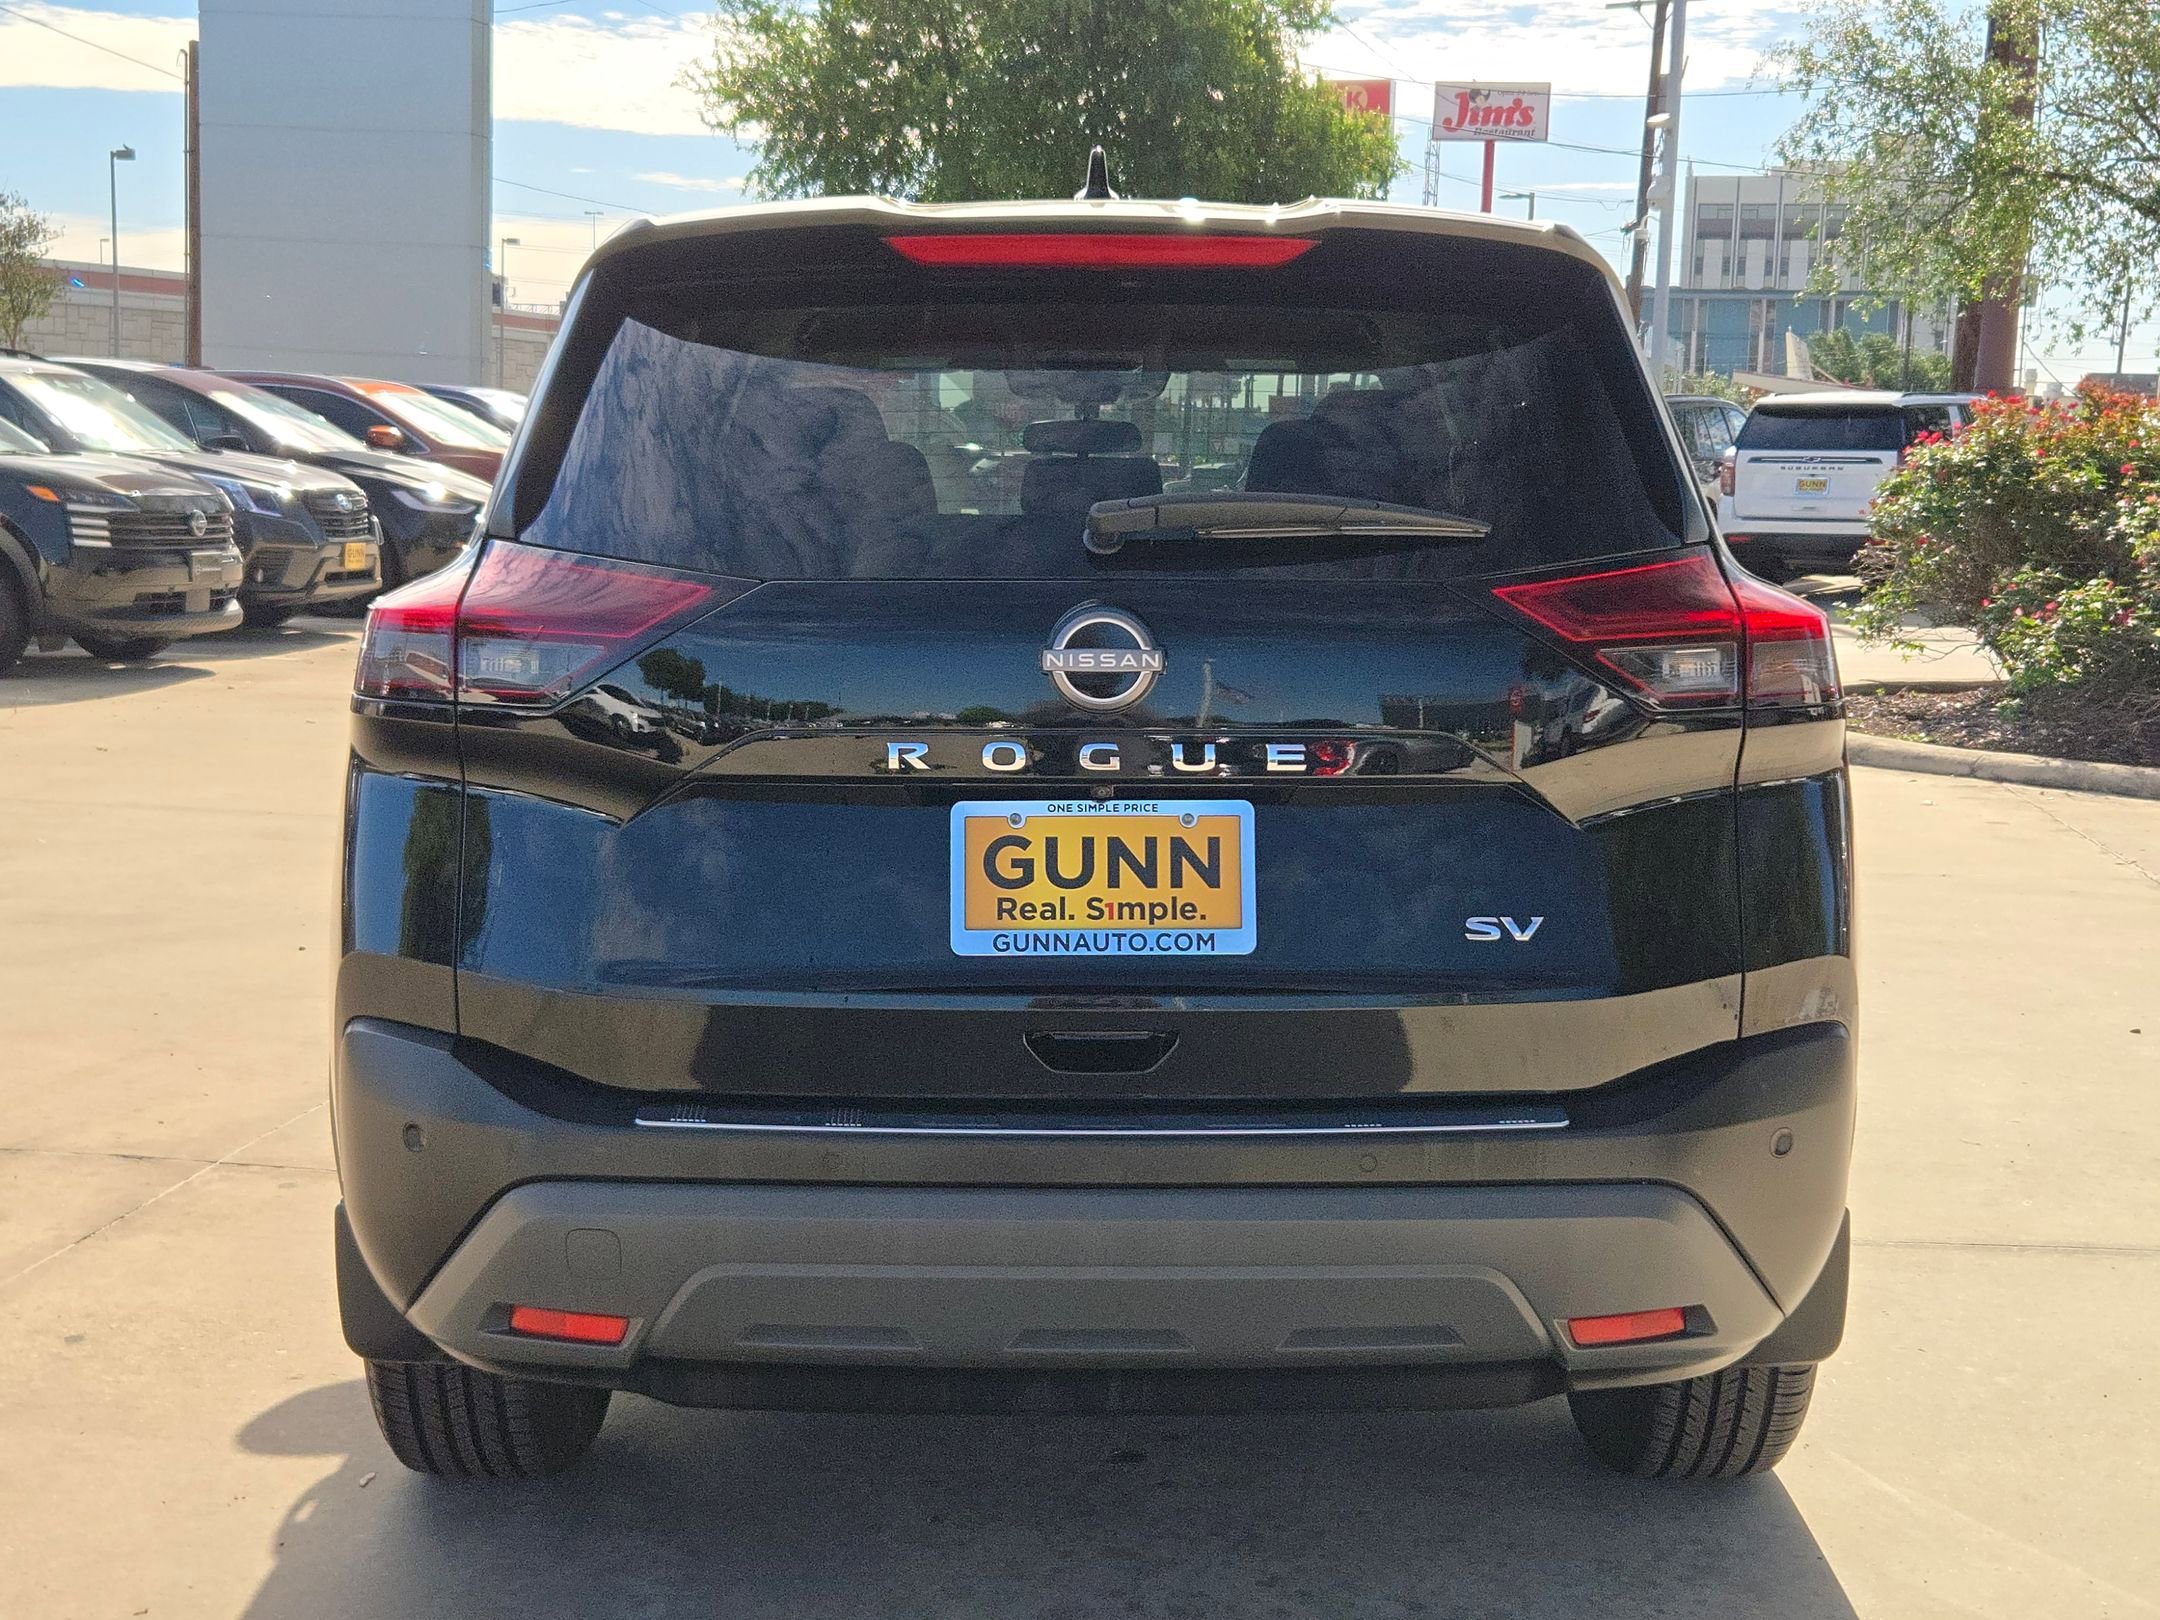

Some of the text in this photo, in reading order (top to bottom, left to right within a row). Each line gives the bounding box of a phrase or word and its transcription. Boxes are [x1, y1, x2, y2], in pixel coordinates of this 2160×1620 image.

[1442, 91, 1535, 132] Jim's
[1799, 480, 1826, 489] GUNN
[1045, 652, 1160, 668] NISSAN
[887, 741, 1307, 771] ROGUE
[1047, 803, 1159, 813] ONE SIMPLE PRICE
[982, 834, 1221, 890] GUNN
[996, 895, 1075, 921] Real.
[1464, 916, 1544, 941] SV
[992, 932, 1216, 953] GUNNAUTO.COM
